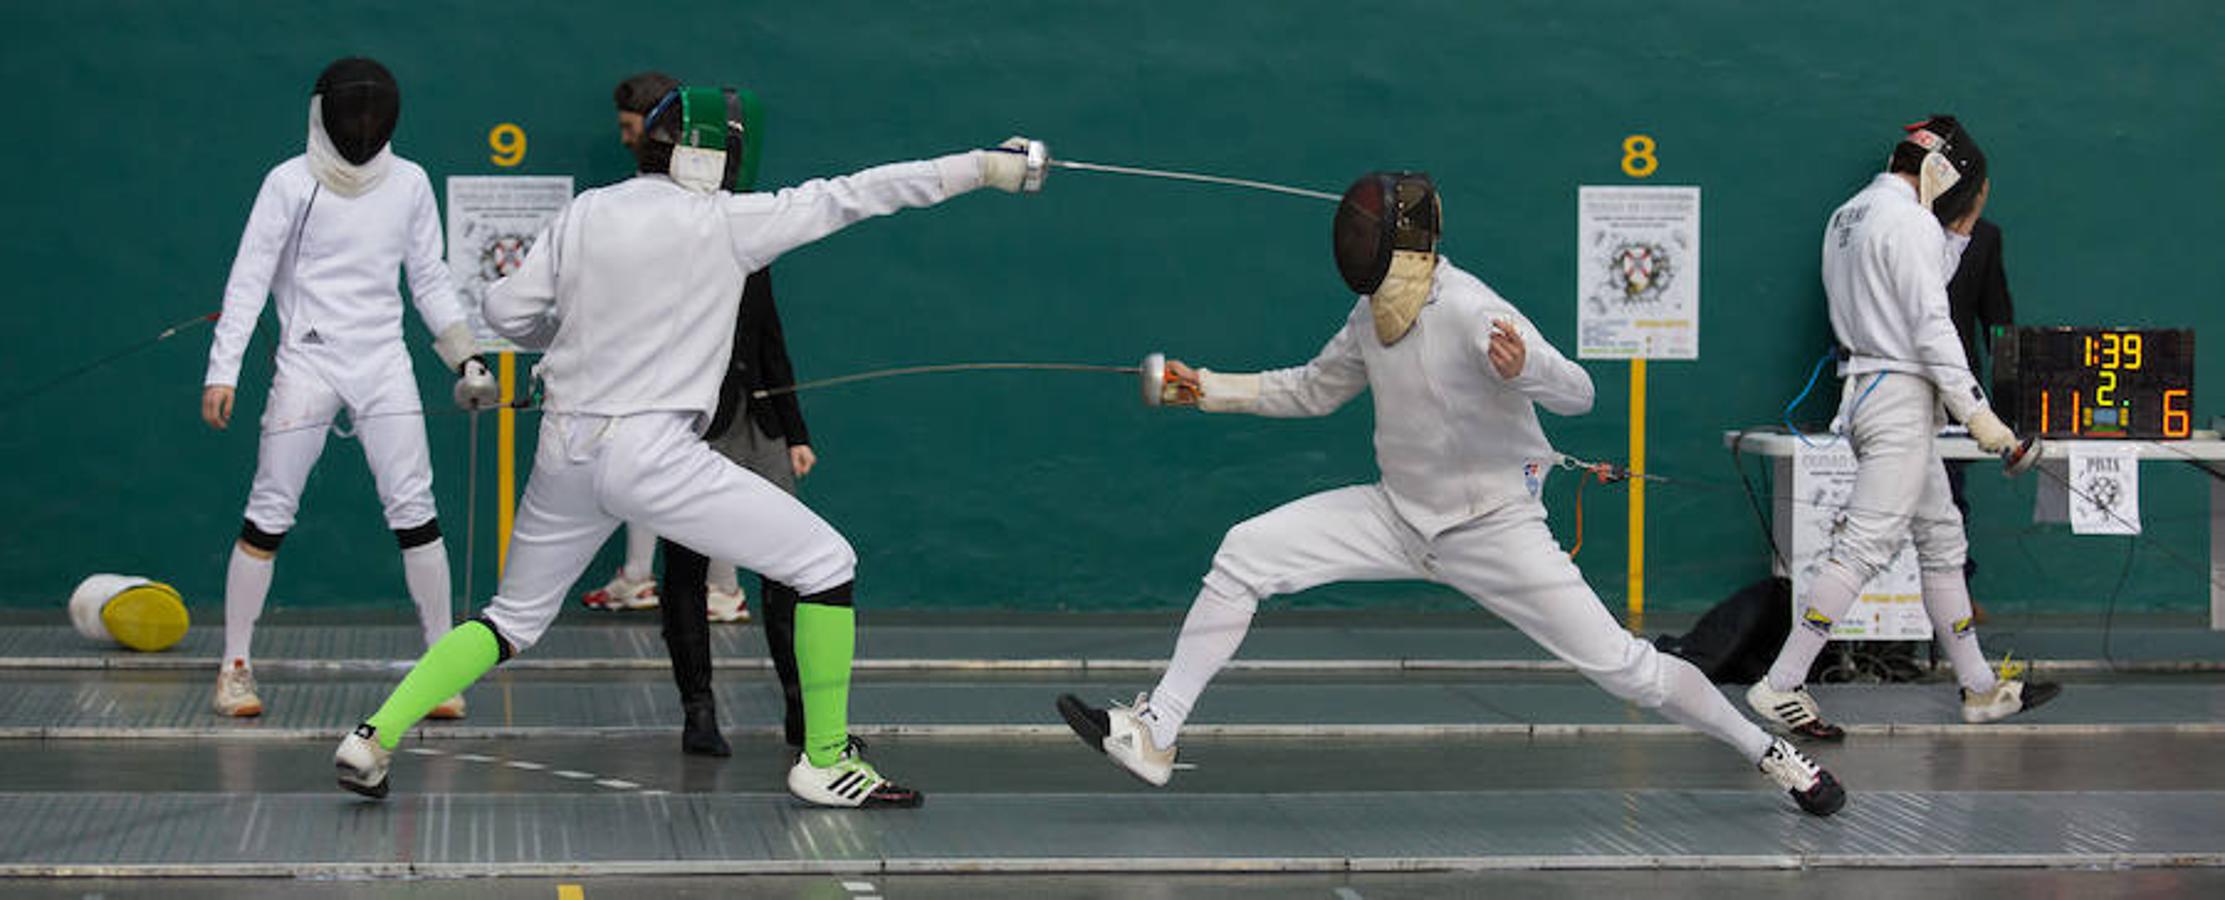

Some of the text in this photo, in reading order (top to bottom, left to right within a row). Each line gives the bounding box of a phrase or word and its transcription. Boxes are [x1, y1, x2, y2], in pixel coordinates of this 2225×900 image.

[489, 123, 526, 167] 9
[1621, 135, 1658, 177] 8
[2085, 333, 2142, 369] 1:39
[2041, 390, 2080, 435] 11
[2162, 389, 2190, 438] 6
